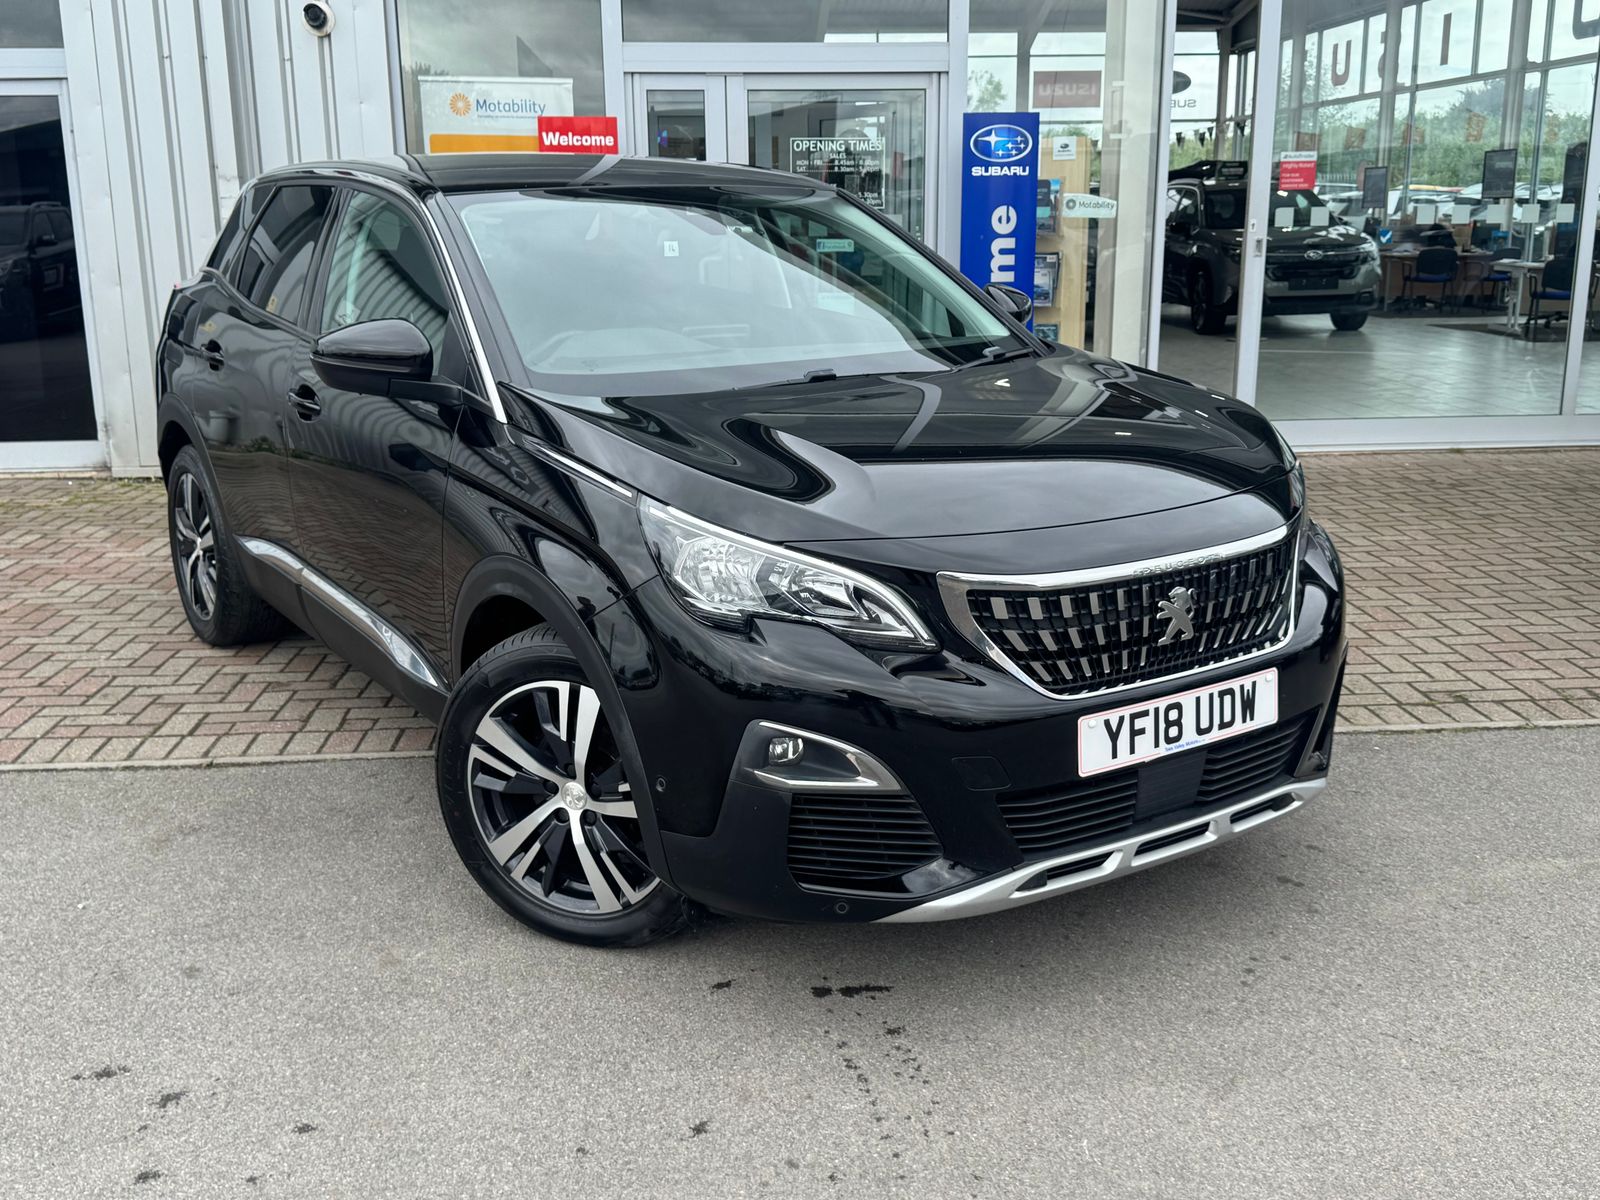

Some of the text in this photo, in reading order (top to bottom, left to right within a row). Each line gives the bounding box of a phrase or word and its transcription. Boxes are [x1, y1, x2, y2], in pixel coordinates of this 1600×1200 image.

[476, 98, 546, 116] Motability
[541, 131, 615, 146] Welcome
[793, 140, 882, 151] OPENING TIMES
[971, 166, 1030, 176] SUBARU
[1078, 201, 1115, 211] Motability
[1103, 680, 1257, 760] YF18 UDW
